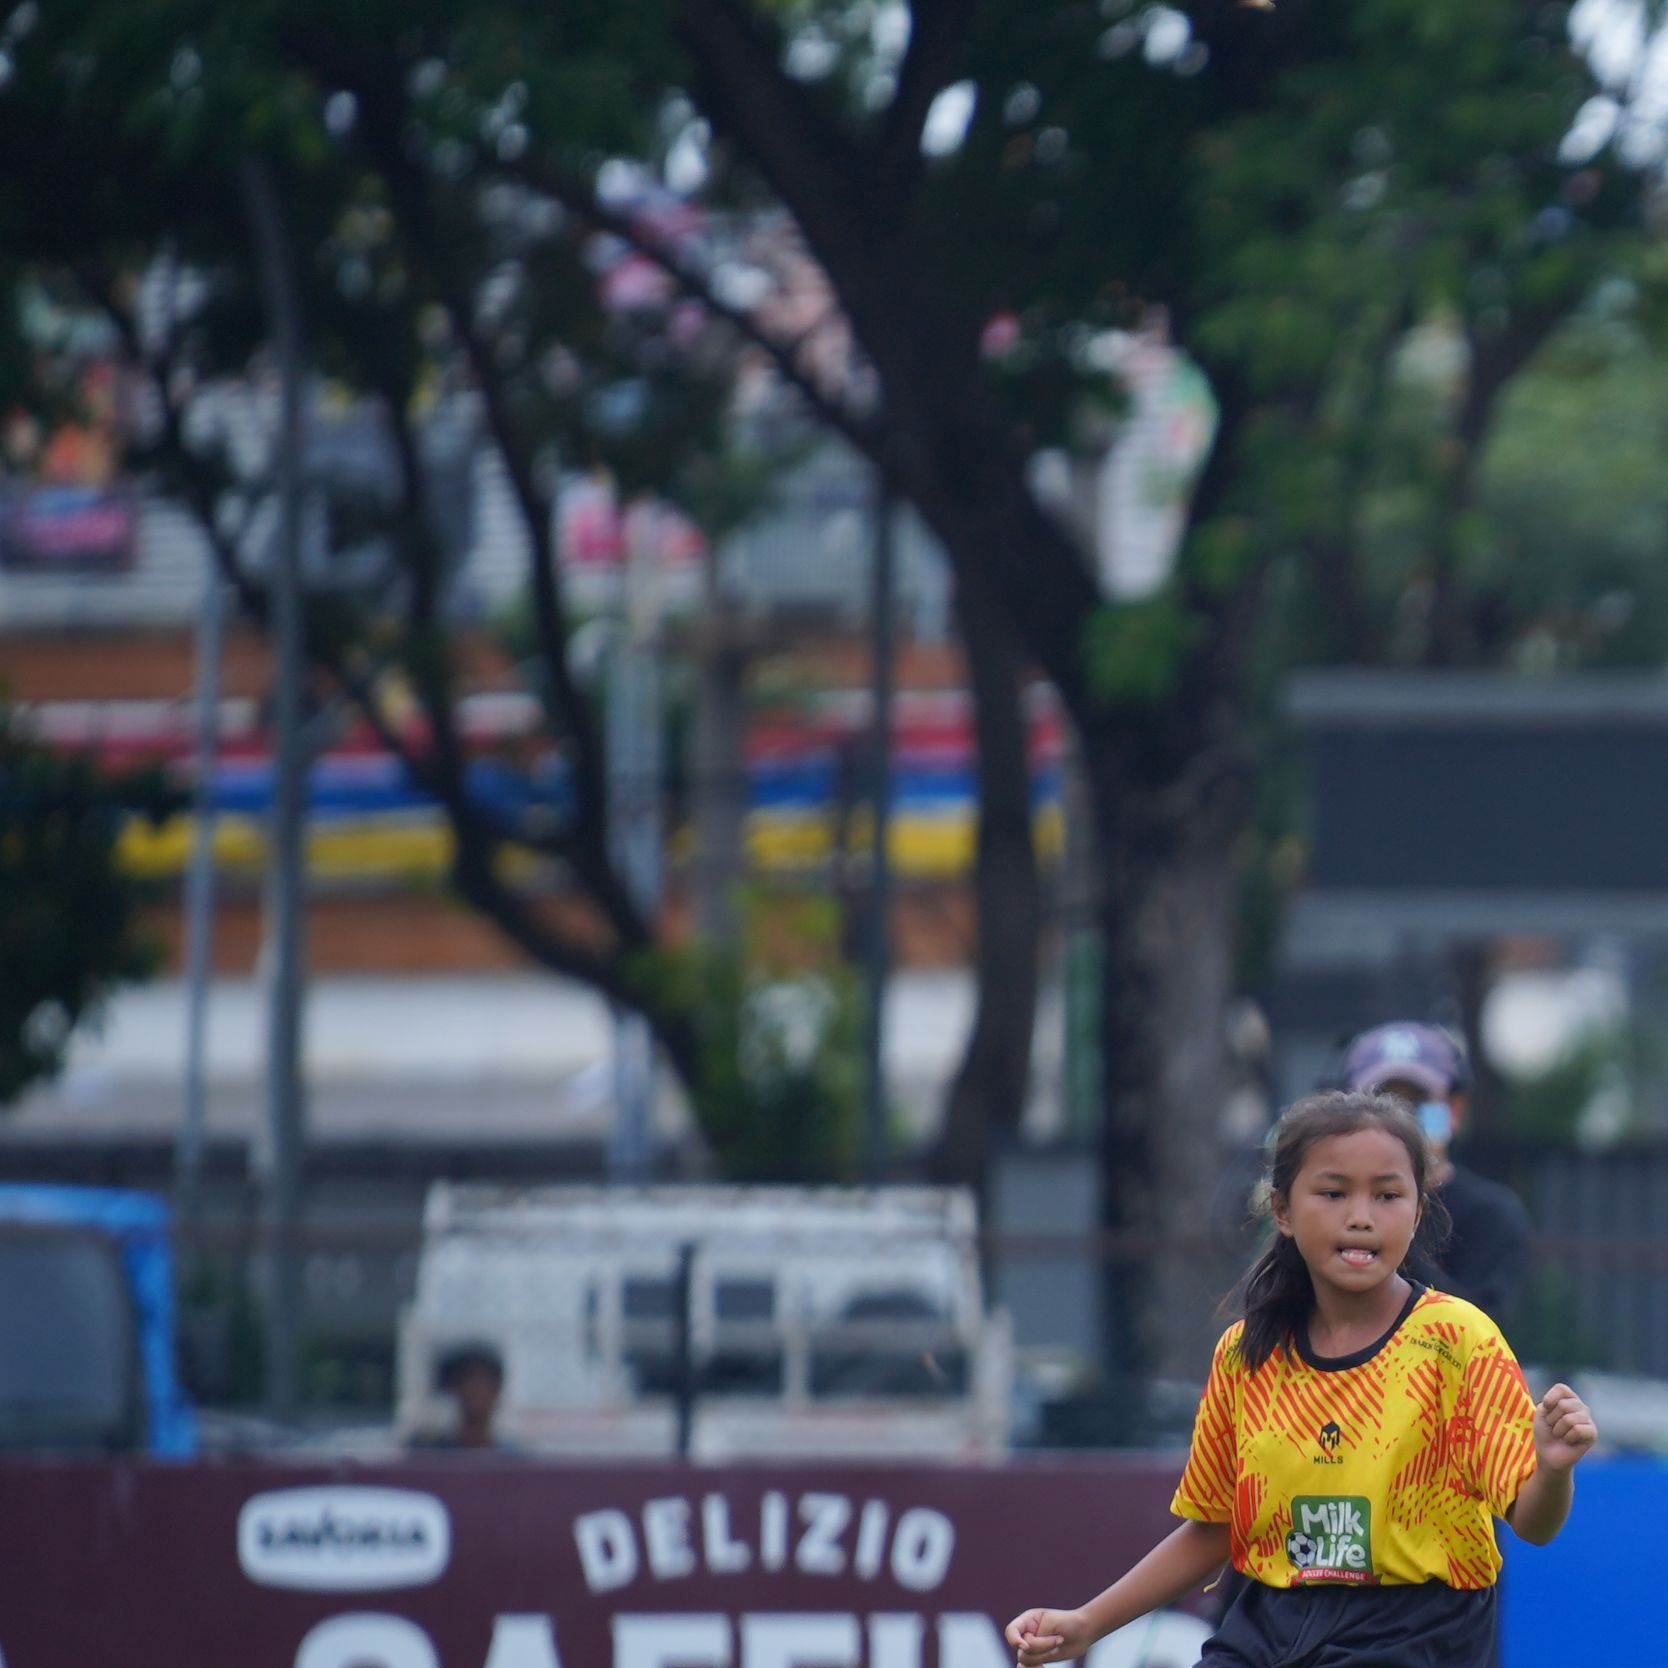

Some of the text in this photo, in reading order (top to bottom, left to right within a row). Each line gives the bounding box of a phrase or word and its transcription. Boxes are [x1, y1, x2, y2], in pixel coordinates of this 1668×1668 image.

[1313, 1455, 1344, 1465] MILLS
[1300, 1501, 1364, 1537] Milk
[573, 1491, 955, 1594] DELIZIO
[1316, 1534, 1367, 1569] Life
